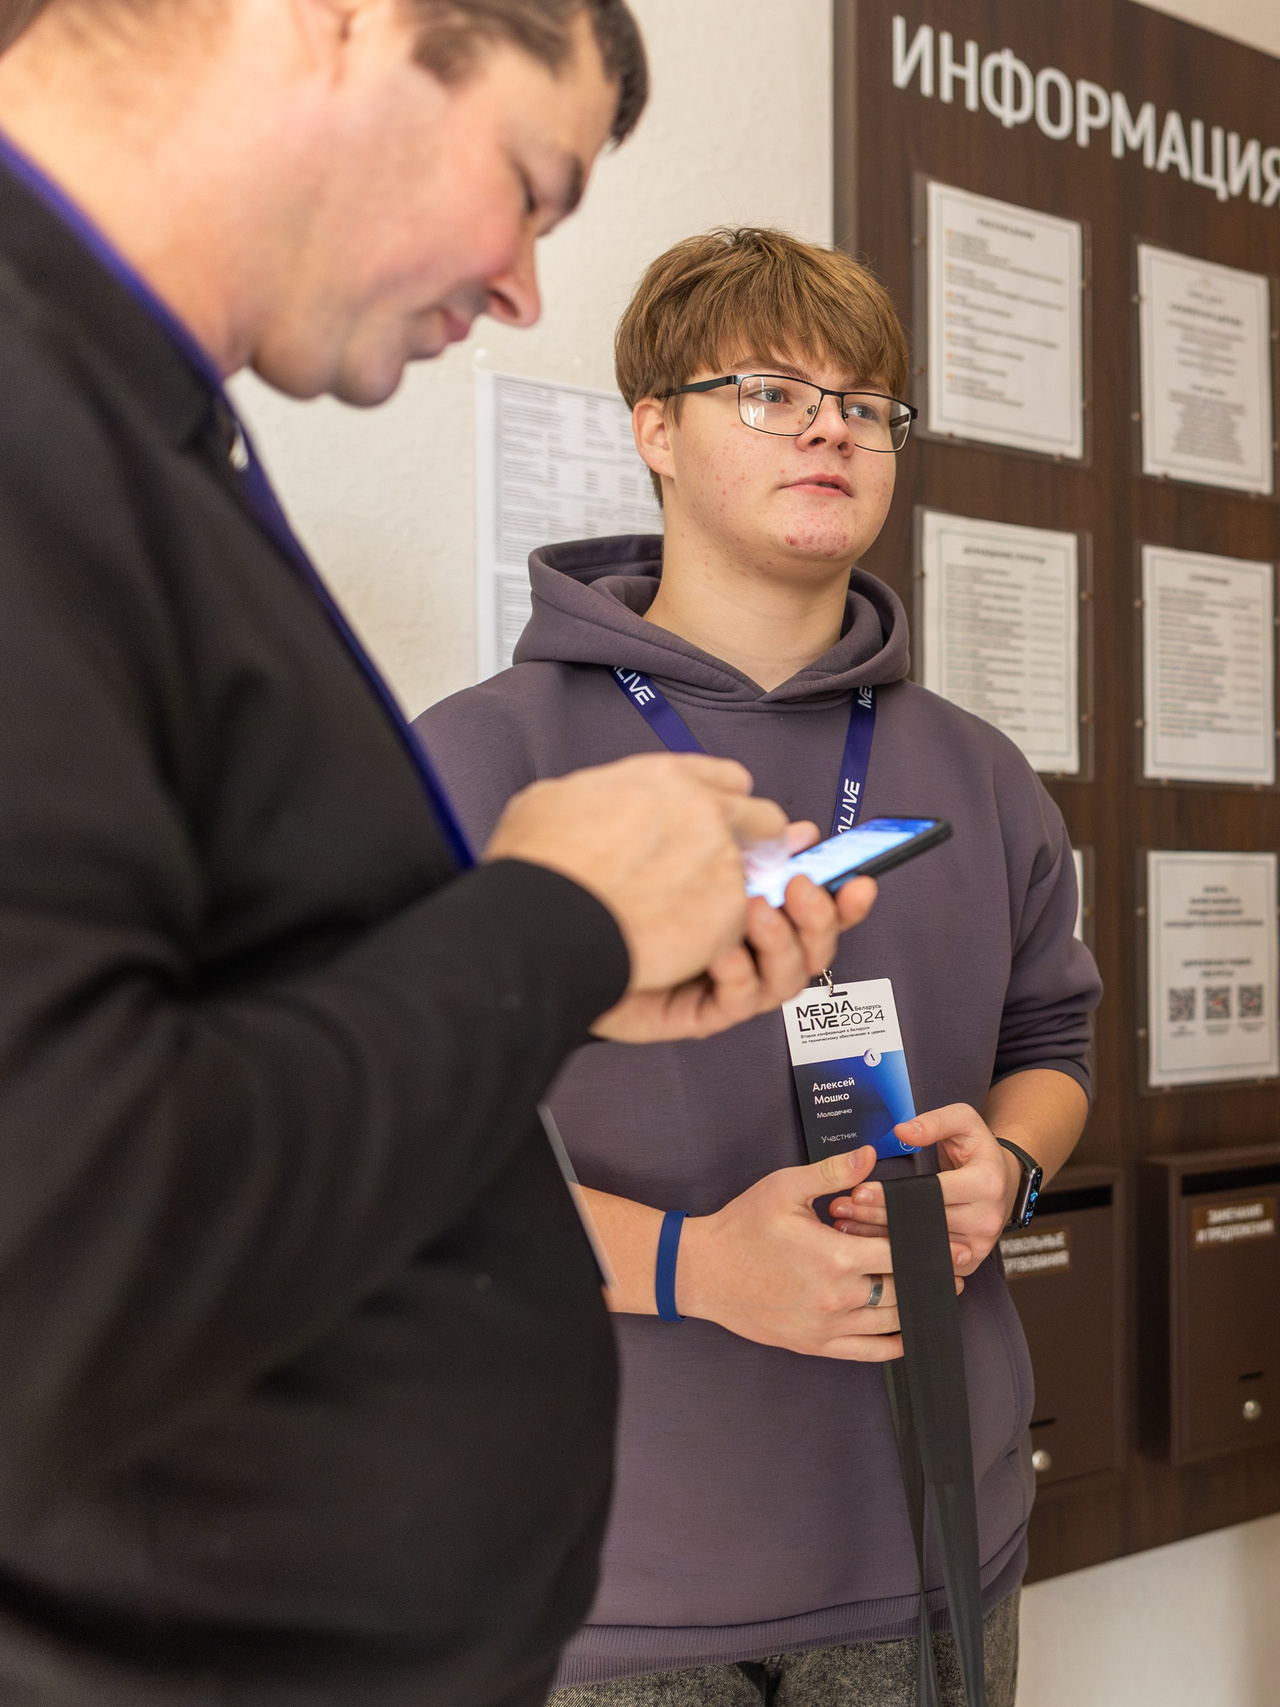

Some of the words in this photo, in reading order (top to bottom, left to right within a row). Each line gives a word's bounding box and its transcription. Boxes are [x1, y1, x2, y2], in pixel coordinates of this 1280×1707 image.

[614, 666, 656, 706] LIVE
[796, 1000, 854, 1018] MEDIA
[813, 1077, 855, 1092] Алексей
[814, 1093, 849, 1105] Мошко
[817, 1108, 852, 1118] Молодечно
[821, 1132, 857, 1143] Участник
